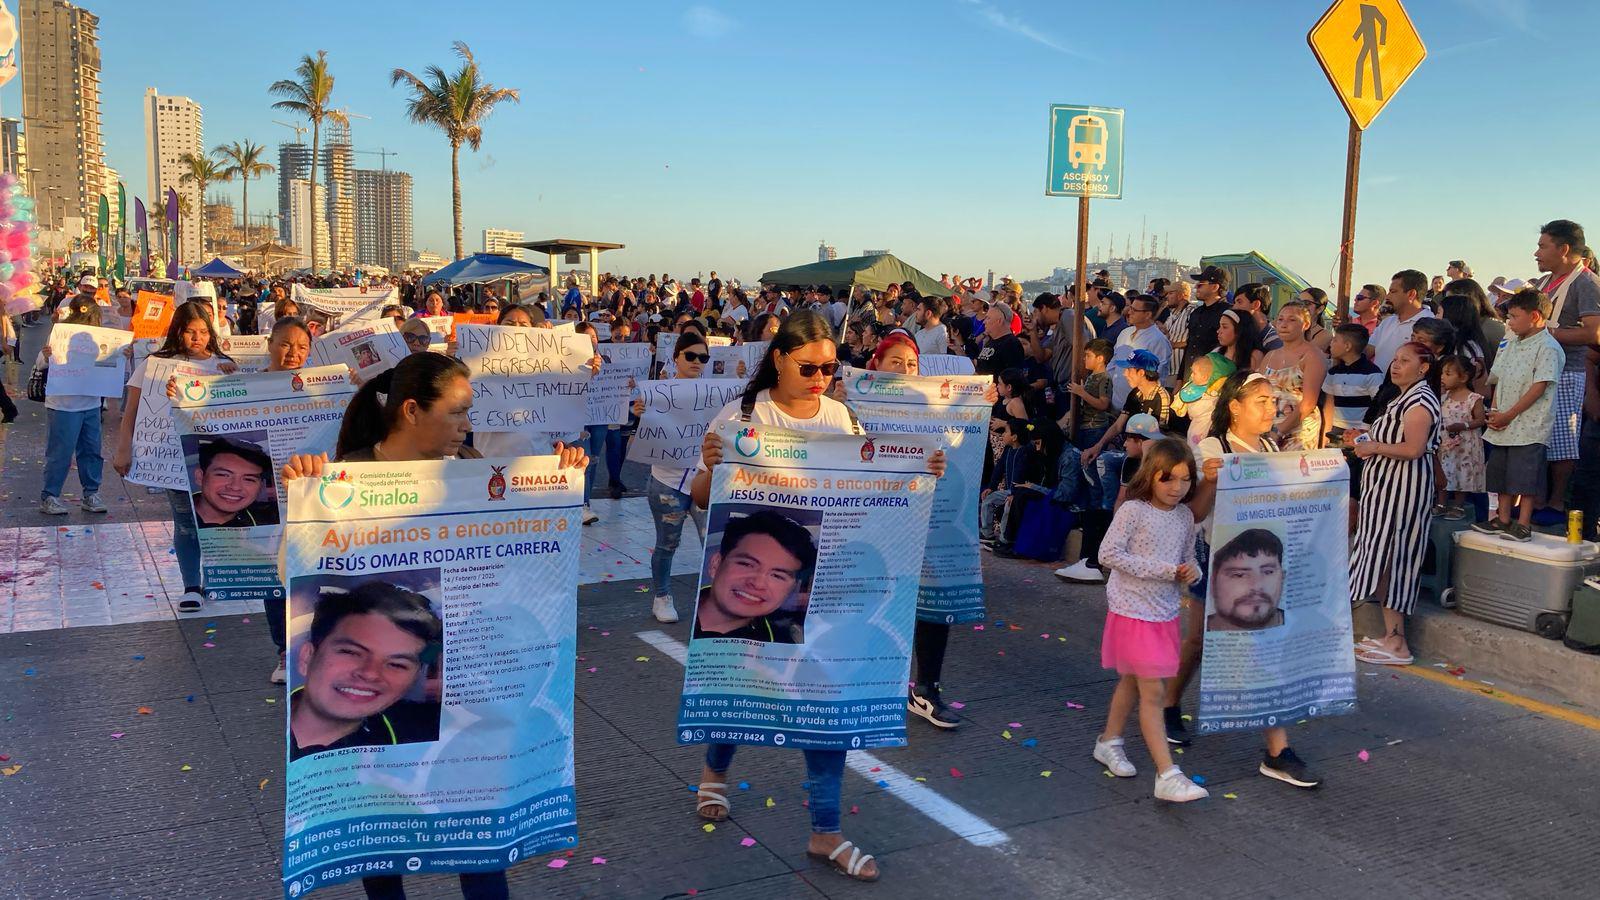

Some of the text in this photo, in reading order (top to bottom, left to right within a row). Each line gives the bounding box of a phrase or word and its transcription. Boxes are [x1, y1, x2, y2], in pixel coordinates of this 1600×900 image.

[1063, 172, 1110, 182] ASCENSO Y
[1063, 182, 1108, 192] DESCENSO
[460, 328, 573, 357] ¡AYUDENME
[481, 357, 551, 378] REGRESAR
[561, 361, 572, 375] A
[307, 374, 344, 383] SINALOA
[210, 388, 247, 400] Sinaloa
[502, 382, 535, 400] MI
[536, 382, 589, 398] FAMILIA
[874, 384, 905, 396] Sinaloa
[953, 384, 984, 392] SINALOA
[191, 405, 258, 423] Ayúdanos
[262, 406, 270, 415] a
[274, 400, 337, 413] encontrar
[486, 406, 546, 427] ESPERA!
[194, 412, 344, 433] JESÚS OMAR RODARTE CARRERA
[640, 422, 709, 440] UNA VIDA
[881, 422, 915, 433] MICHELL
[915, 425, 949, 434] MALAGA
[951, 425, 982, 434] ESTRADA
[764, 446, 807, 460] Sinaloa
[879, 445, 924, 454] SINALOA
[136, 461, 169, 471] KEVIN
[1311, 459, 1340, 467] SINALOA
[511, 474, 568, 486] SINALOA
[733, 467, 918, 491] Ayúdanos a encontrar a
[360, 488, 418, 507] Sinaloa
[730, 488, 909, 508] JESÚS OMAR RODARTE CARRERA
[1249, 509, 1276, 520] MIGUEL
[1278, 506, 1307, 516] GUZMÁN
[1309, 503, 1331, 513] OSUNA
[321, 517, 567, 551] Ayúdanos a encontrar a
[317, 540, 561, 571] JESÚS OMAR RODARTE CARRERA
[685, 699, 695, 707] Si
[699, 698, 728, 707] tienes
[733, 699, 792, 712] información
[797, 704, 839, 714] referente
[851, 705, 867, 713] esta
[683, 709, 710, 718] llama
[782, 714, 793, 723] Tu
[796, 716, 825, 726] ayuda
[828, 717, 839, 726] es
[841, 717, 859, 727] muy
[710, 731, 765, 742] 669 327 8424
[288, 794, 572, 852] Si tienes información referente a esta persona,
[288, 848, 318, 868] llama
[321, 845, 330, 854] o
[415, 832, 430, 842] Tu
[434, 829, 473, 844] ayuda
[477, 829, 492, 840] es
[496, 825, 517, 839] muy
[519, 808, 572, 830] importante.
[321, 860, 394, 881] 669 327 8424
